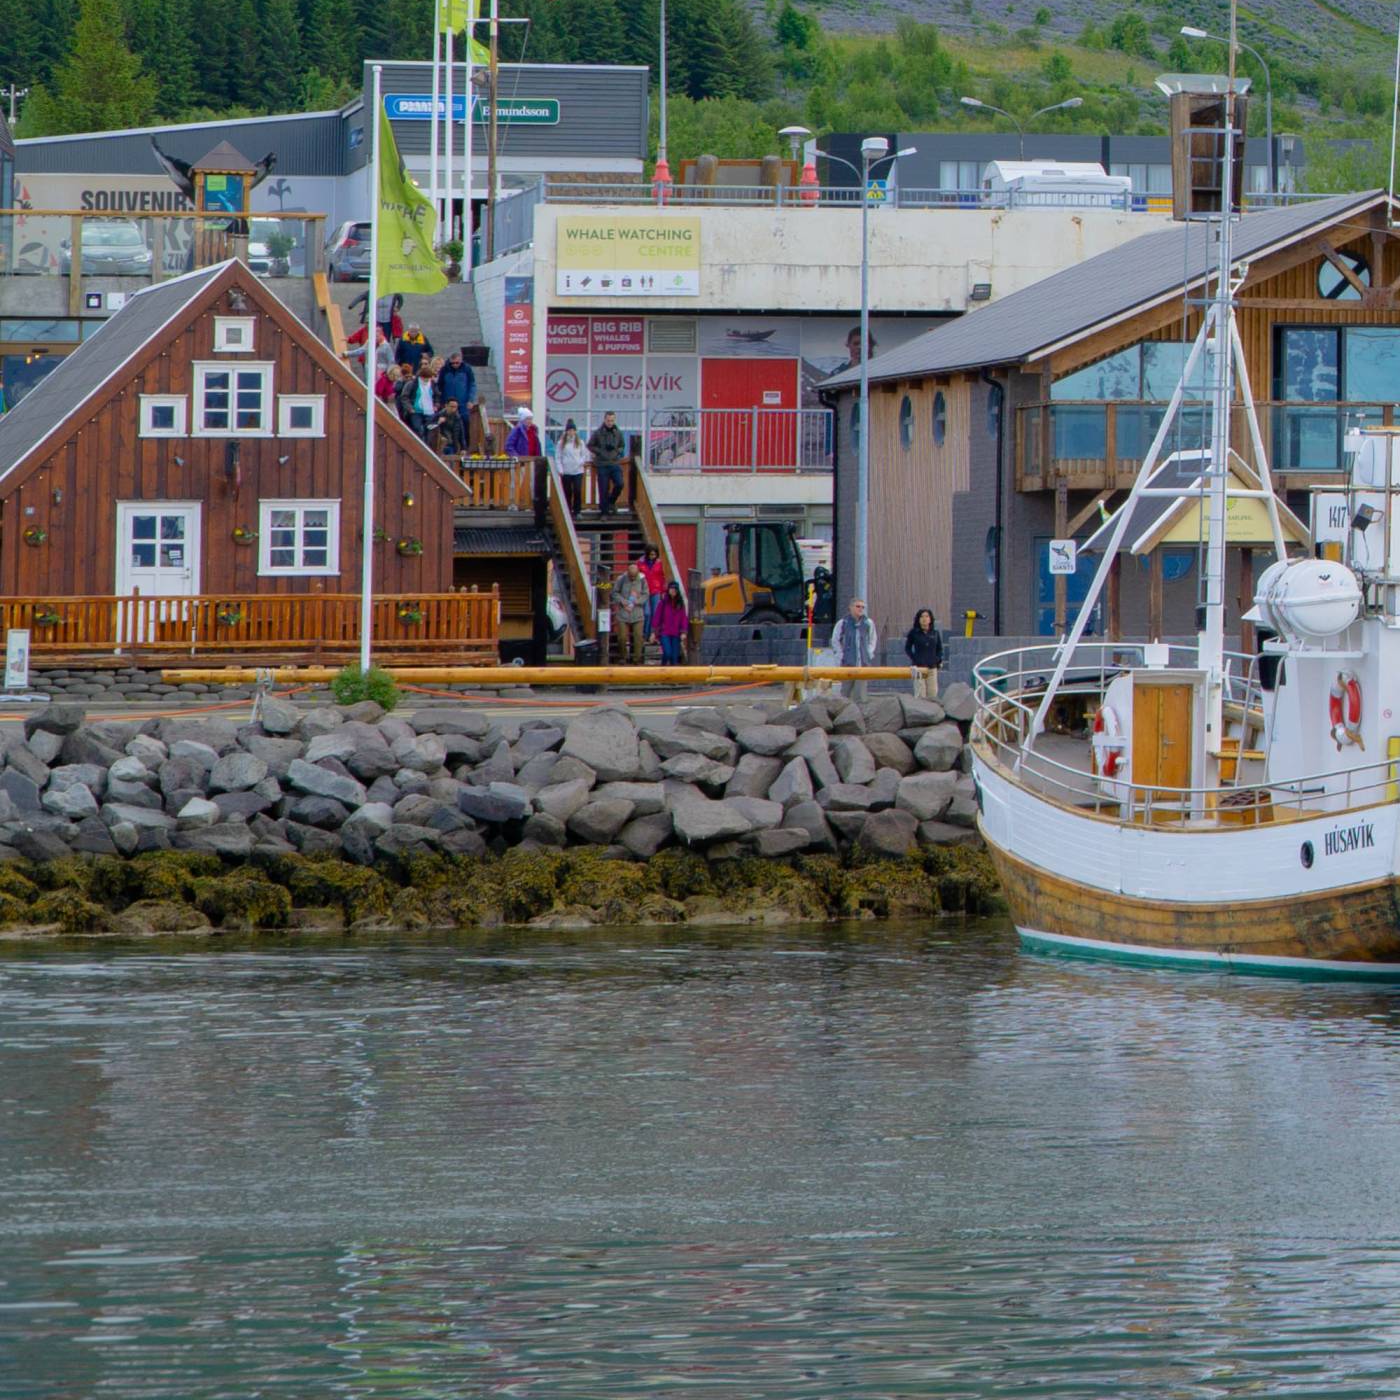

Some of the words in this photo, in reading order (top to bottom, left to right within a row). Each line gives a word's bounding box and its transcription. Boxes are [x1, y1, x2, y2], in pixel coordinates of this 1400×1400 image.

[483, 106, 549, 116] Emundsson
[81, 190, 195, 212] SOUVENIR
[566, 229, 615, 240] WHALE
[618, 229, 692, 240] WATCHING
[638, 245, 693, 257] CENTRE
[547, 324, 586, 335] UGGY
[592, 322, 617, 332] BIG
[619, 322, 642, 332] RIB
[546, 336, 588, 344] VENTURES
[593, 334, 631, 342] WHALES
[605, 343, 641, 351] PUFFINS
[593, 372, 683, 391] HÚSAVÍK
[1324, 818, 1375, 856] HÚSAVÍK
